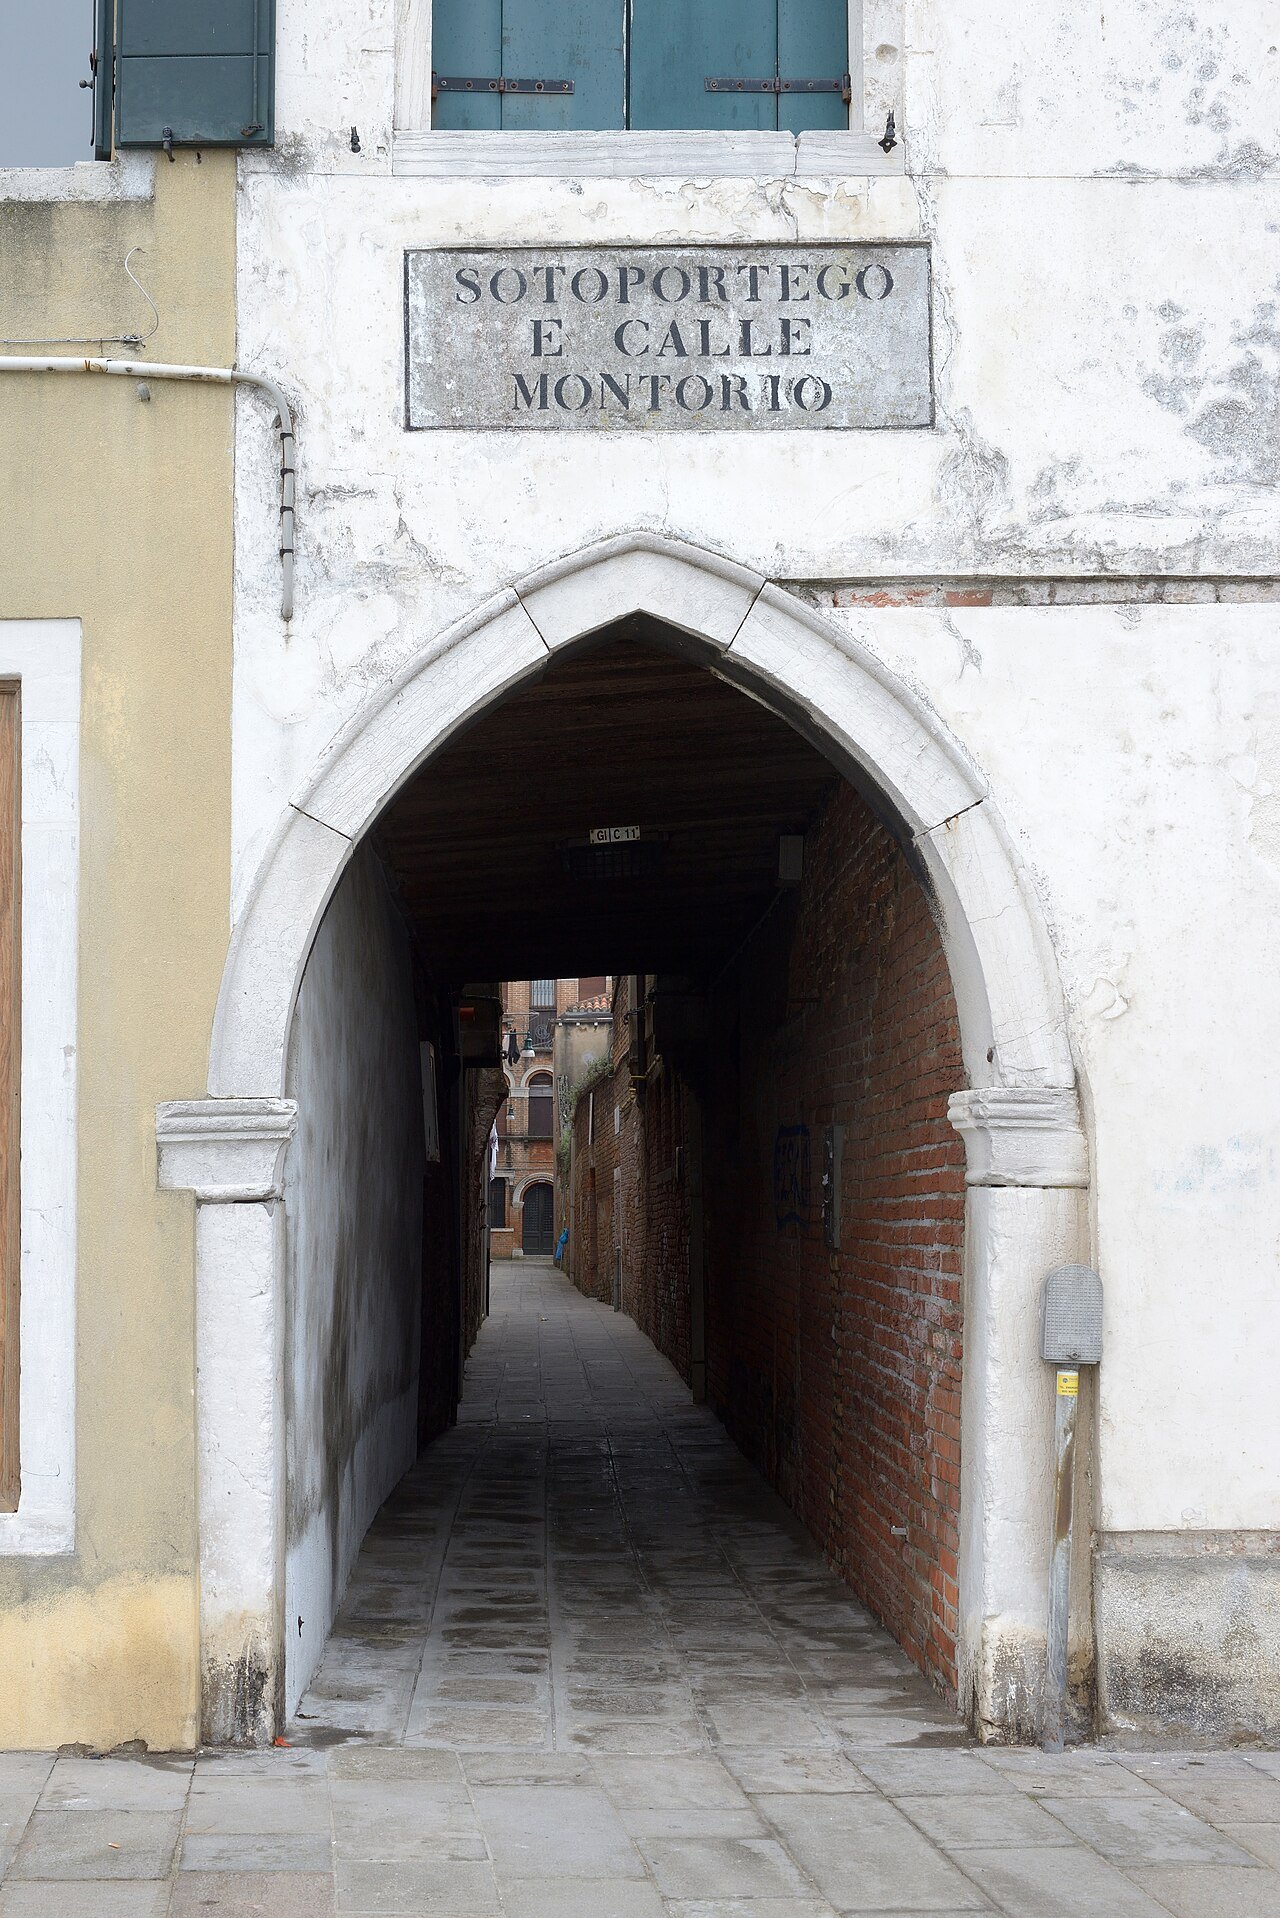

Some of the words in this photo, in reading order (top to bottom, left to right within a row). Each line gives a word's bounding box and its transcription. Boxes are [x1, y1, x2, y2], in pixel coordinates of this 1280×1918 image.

[455, 264, 894, 304] SOTOPORTEGO
[530, 318, 563, 358] E
[614, 317, 812, 358] CALLE
[512, 372, 833, 412] MONTORIO
